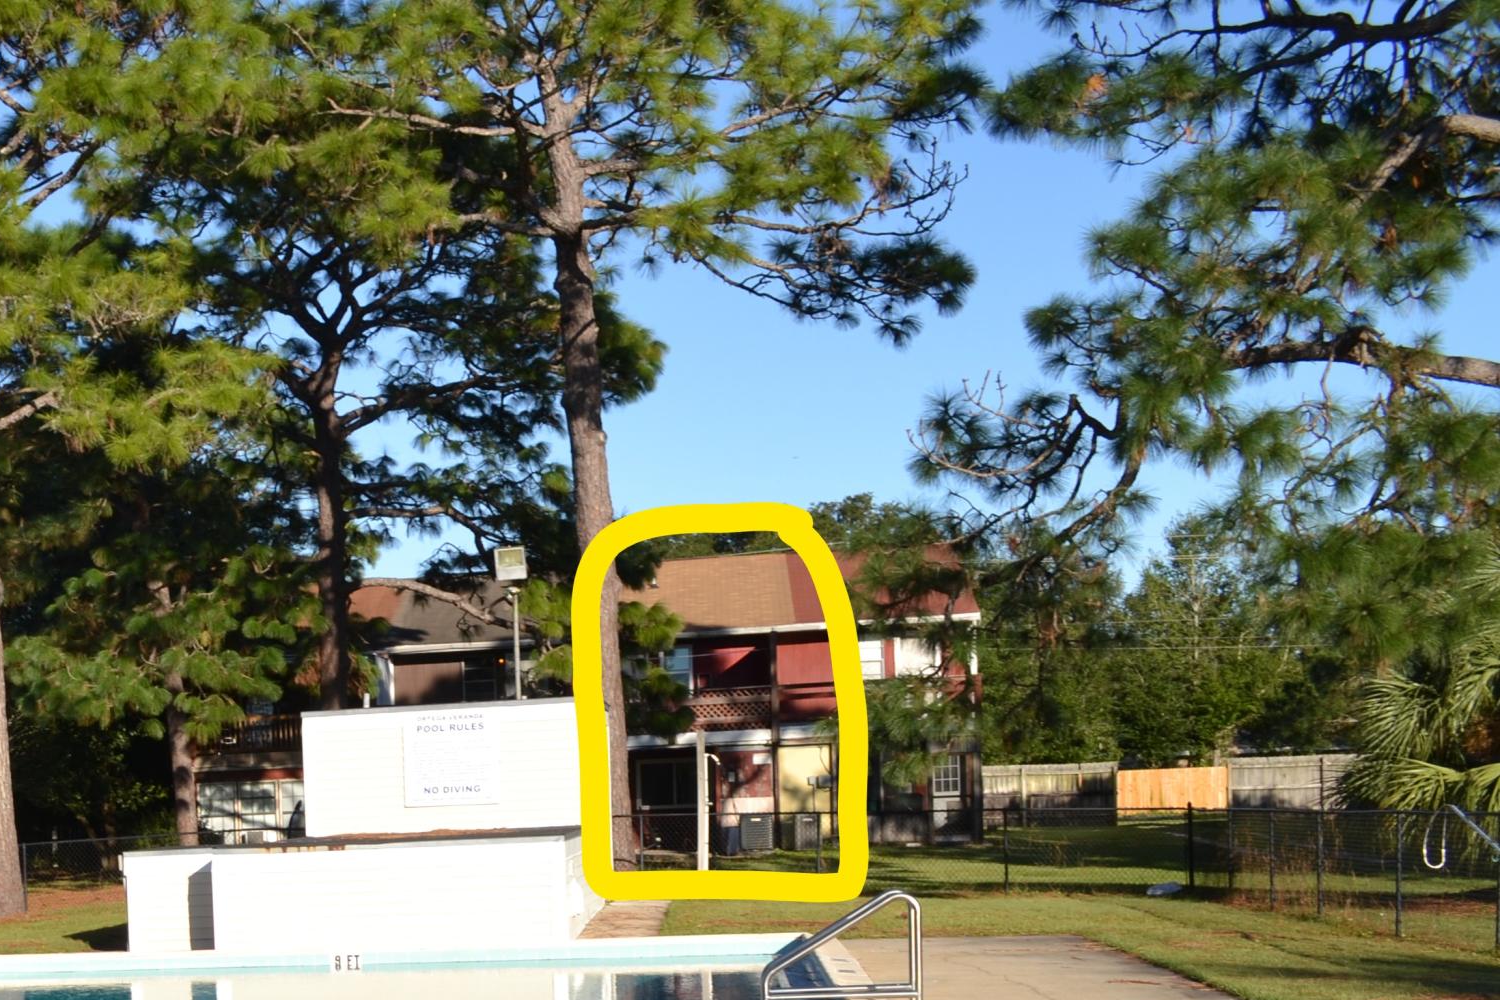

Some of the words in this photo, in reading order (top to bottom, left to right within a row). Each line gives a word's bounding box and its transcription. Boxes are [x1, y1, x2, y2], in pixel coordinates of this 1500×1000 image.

[416, 724, 445, 733] POOL
[449, 721, 485, 732] RULES
[423, 786, 439, 795] NO
[443, 784, 481, 794] DIVING
